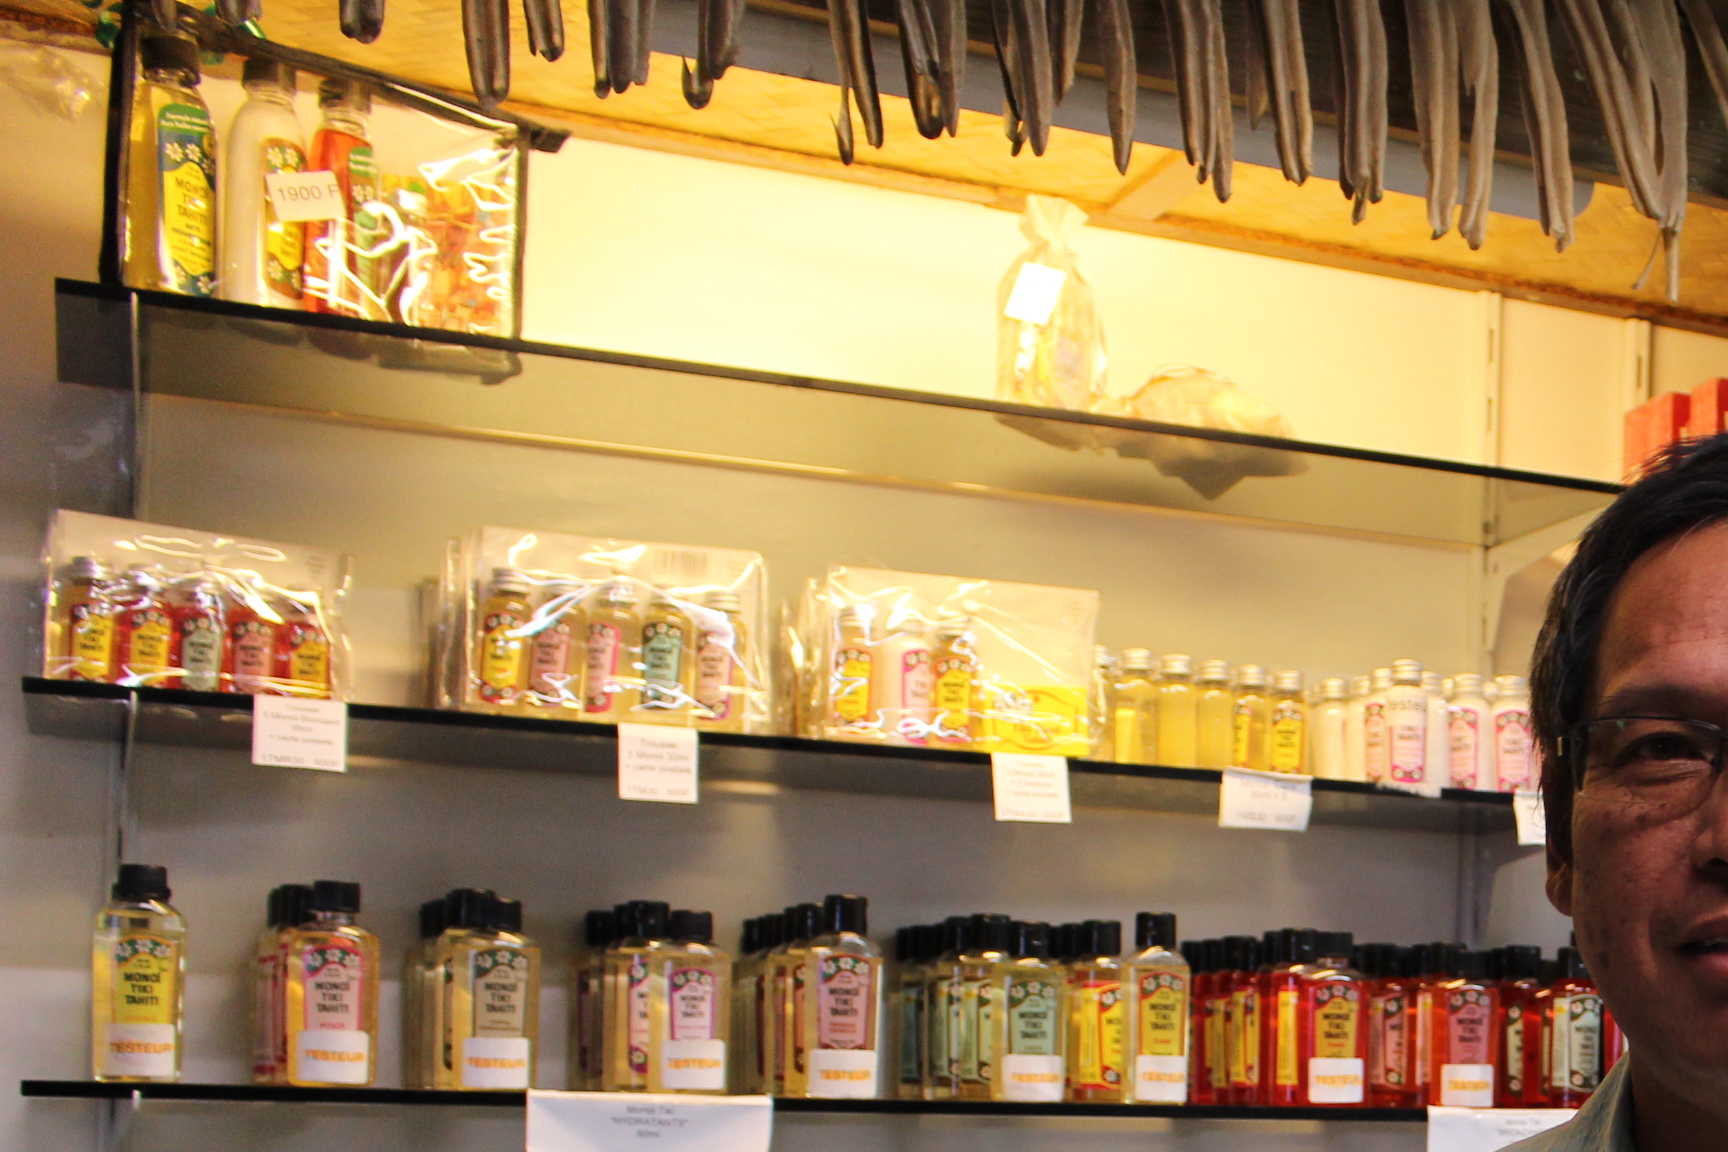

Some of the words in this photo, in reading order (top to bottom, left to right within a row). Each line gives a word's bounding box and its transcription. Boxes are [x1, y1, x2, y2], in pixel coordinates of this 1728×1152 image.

[277, 185, 322, 202] 1900
[328, 184, 340, 198] F
[130, 984, 153, 994] TIKI
[124, 994, 158, 1006] TAHITI
[321, 993, 342, 1002] TIKI
[315, 1003, 348, 1012] TAHITI
[110, 1042, 175, 1053] TESTEUR
